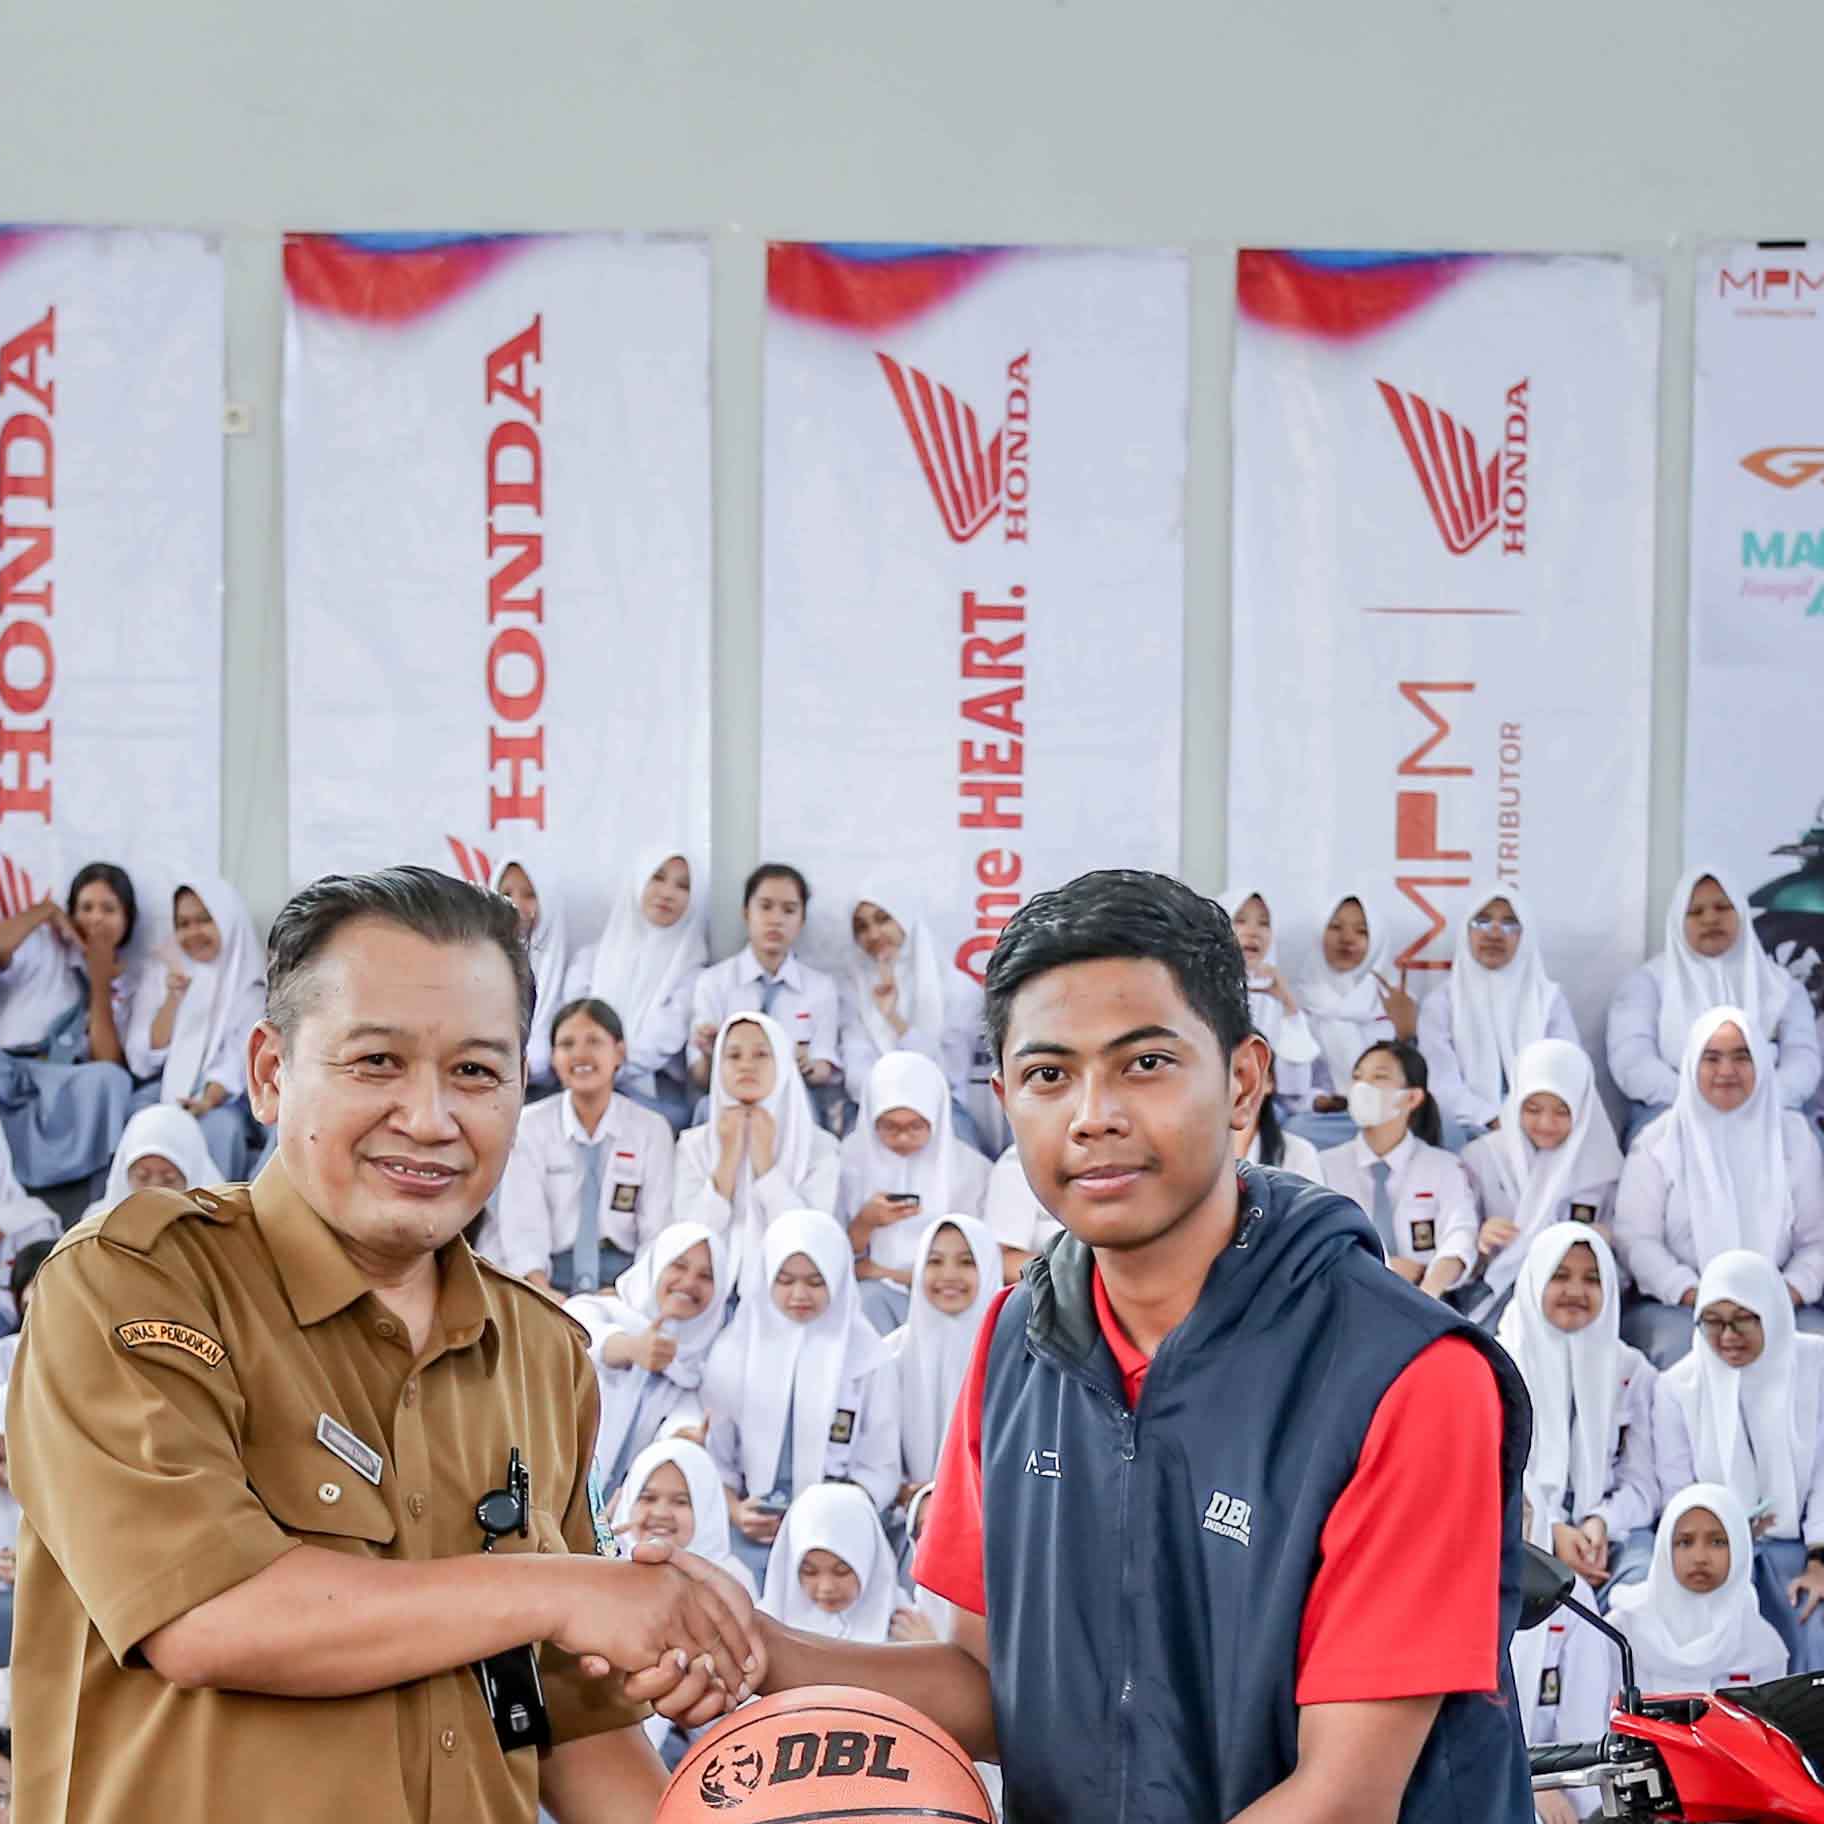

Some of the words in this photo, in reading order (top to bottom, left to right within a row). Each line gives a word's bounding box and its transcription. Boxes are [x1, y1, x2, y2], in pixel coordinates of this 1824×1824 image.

[1004, 351, 1031, 544] HONDA
[1502, 377, 1530, 556] HONDA
[485, 313, 546, 832] HONDA
[959, 585, 1027, 829] HEART.
[1394, 681, 1476, 971] MPM
[122, 1325, 158, 1343] DINAS
[768, 1730, 909, 1786] DBL
